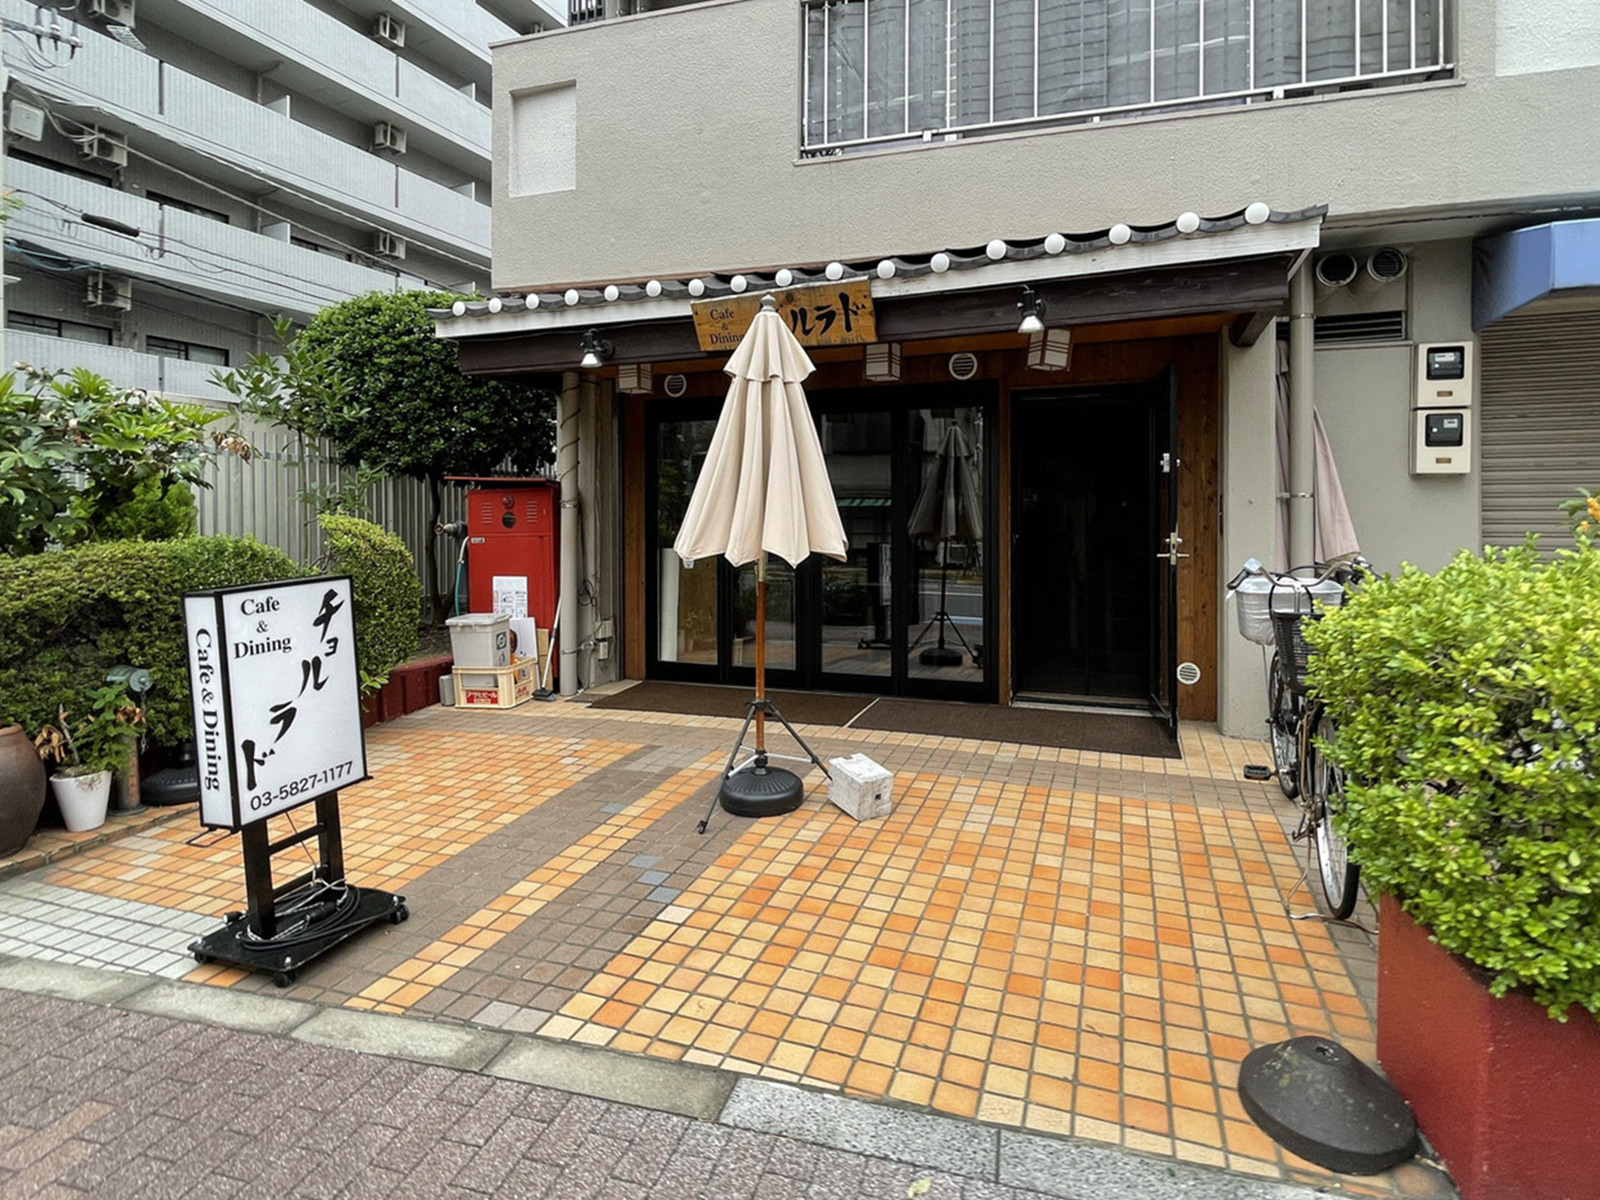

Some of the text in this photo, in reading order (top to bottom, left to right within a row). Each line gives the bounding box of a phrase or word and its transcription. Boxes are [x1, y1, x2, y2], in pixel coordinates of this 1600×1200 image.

[709, 308, 735, 320] Cafe
[774, 292, 867, 336] ルラド
[721, 322, 729, 331] &
[240, 596, 280, 616] Cafe
[256, 620, 269, 633] &
[233, 636, 292, 659] Dining
[241, 588, 346, 791] チョルラド
[195, 628, 222, 791] Cafe & Dining
[250, 761, 353, 811] 03-5827-1177
